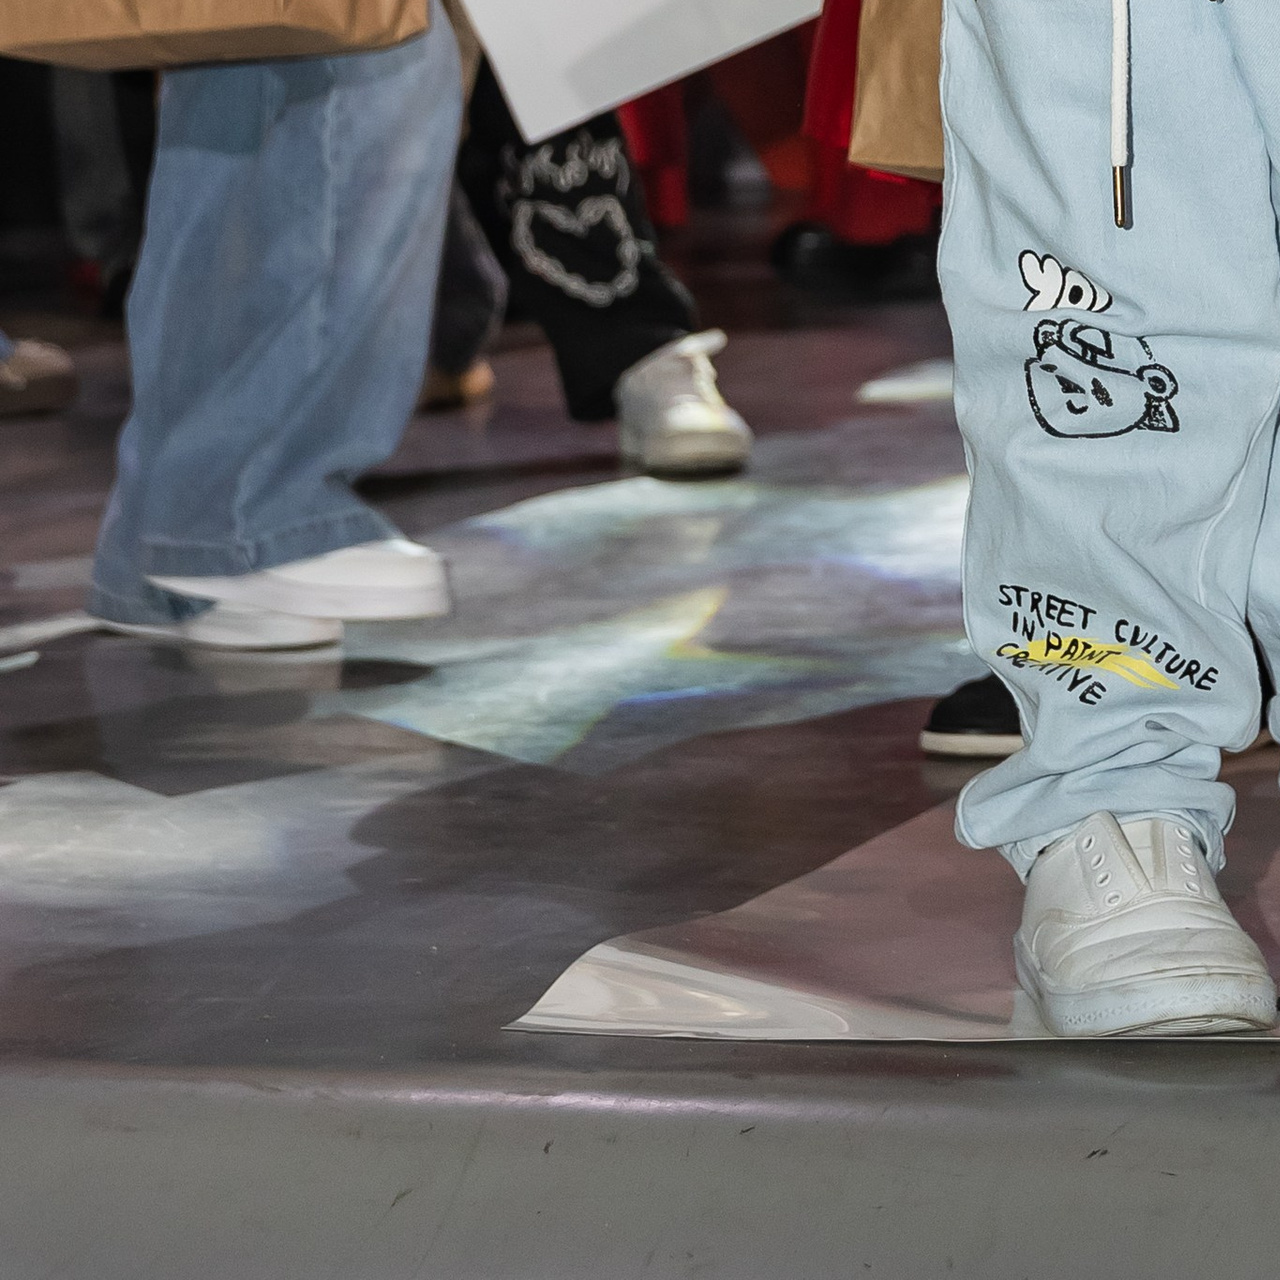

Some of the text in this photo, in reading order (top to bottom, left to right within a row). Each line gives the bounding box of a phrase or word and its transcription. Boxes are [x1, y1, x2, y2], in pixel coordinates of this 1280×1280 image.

[999, 584, 1219, 691] STREET CULTURE
[1012, 611, 1121, 664] IN PAINT
